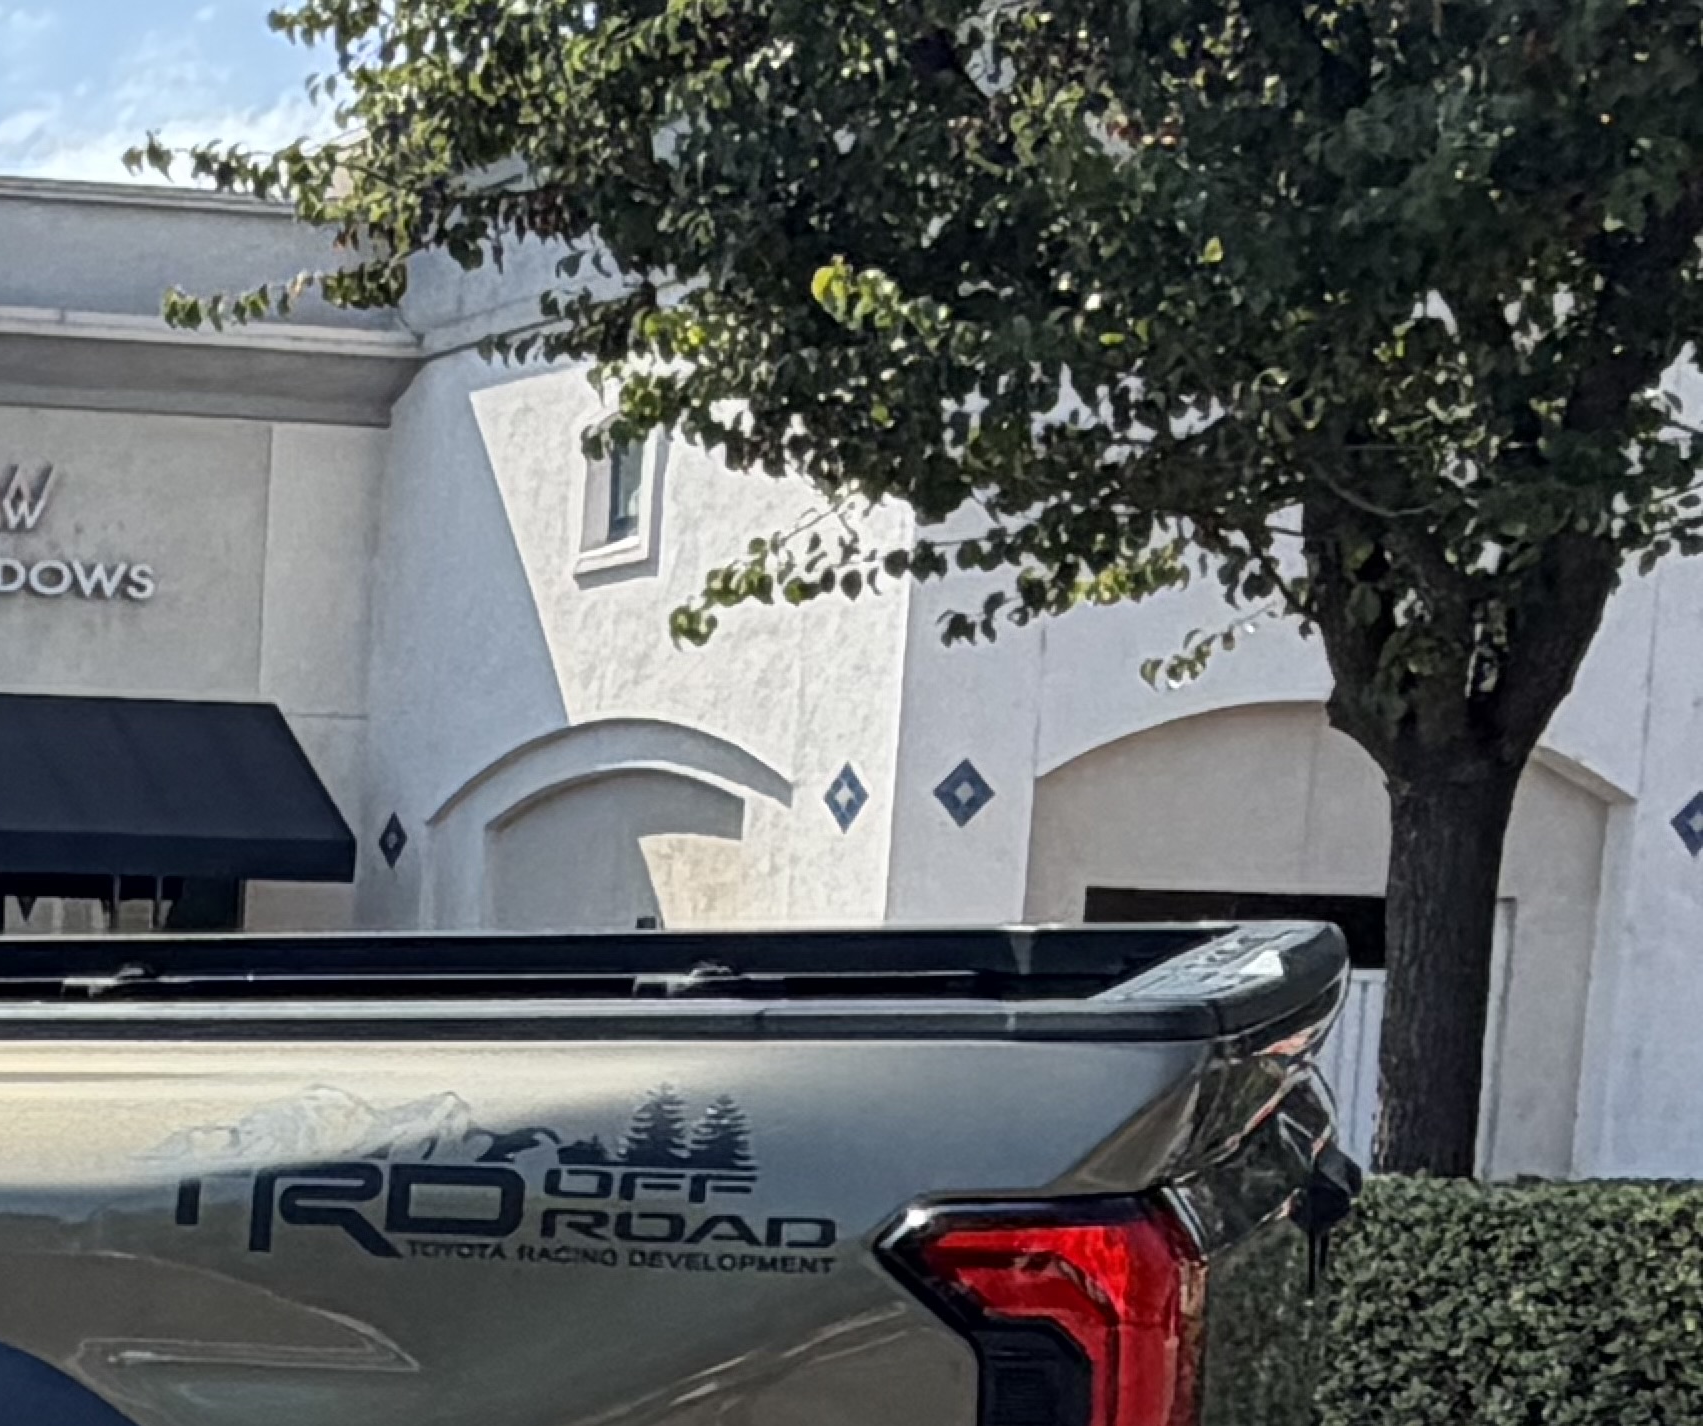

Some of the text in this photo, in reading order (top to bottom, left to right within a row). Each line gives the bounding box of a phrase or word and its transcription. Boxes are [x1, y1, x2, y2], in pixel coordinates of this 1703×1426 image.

[544, 1167, 758, 1204] OFF
[540, 1208, 839, 1249] ROAD
[407, 1239, 838, 1275] TOYOTA RACING DEVELOPMENT
